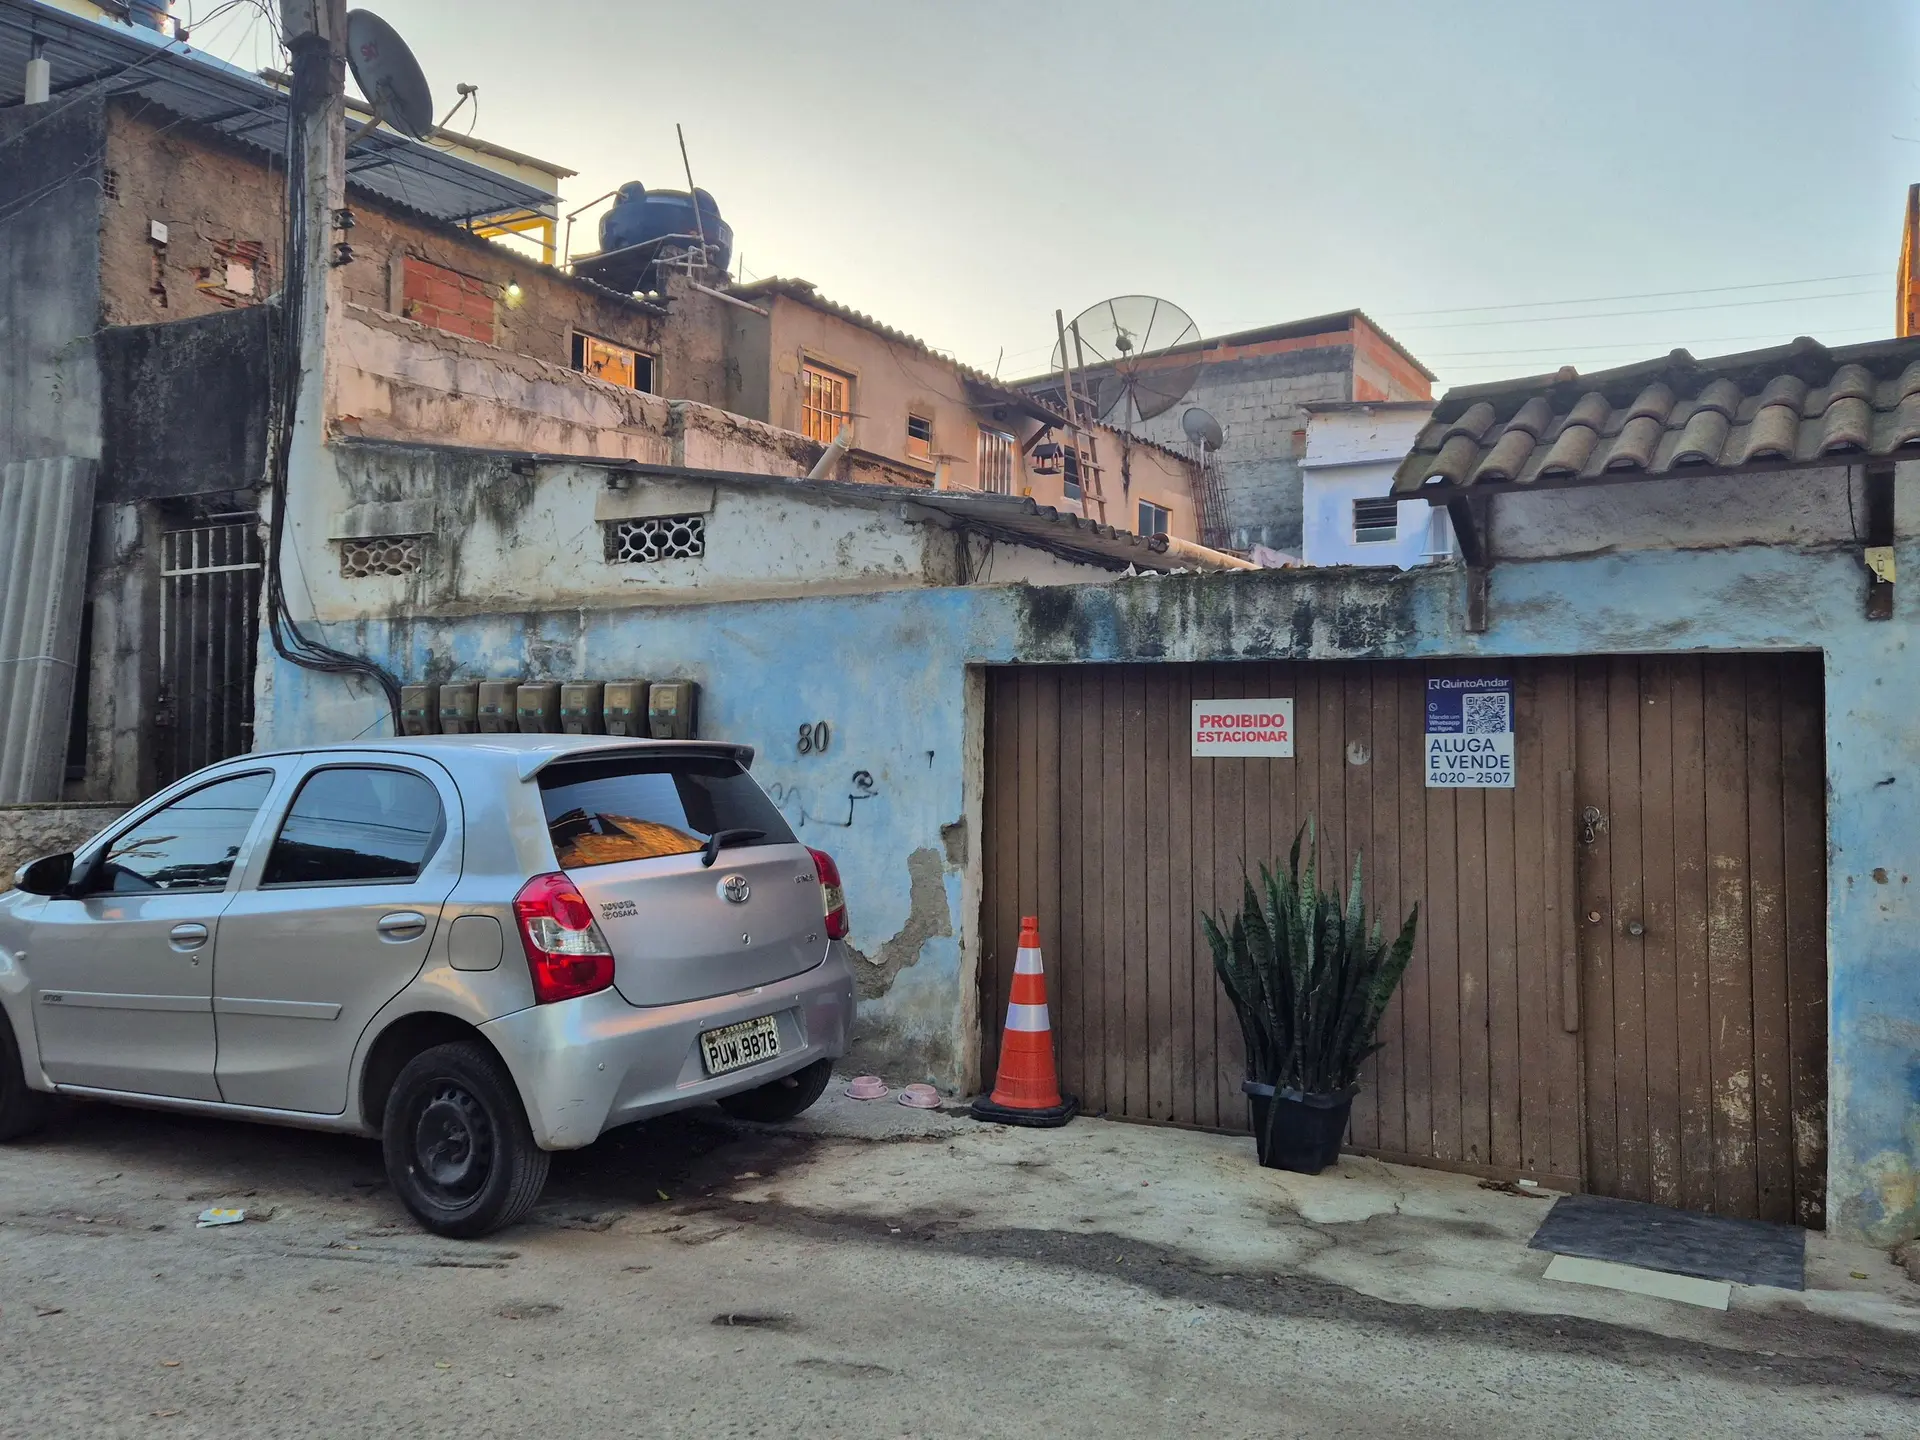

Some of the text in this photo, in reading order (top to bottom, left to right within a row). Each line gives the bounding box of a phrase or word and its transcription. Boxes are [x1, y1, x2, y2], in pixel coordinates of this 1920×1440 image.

[1441, 678, 1509, 689] QuintoAndar
[1199, 714, 1285, 728] PROIBIDO
[797, 720, 829, 754] 80
[1197, 731, 1288, 742] ESTACIONAR
[1430, 738, 1495, 752] ALUGA
[1431, 755, 1510, 769] E VENDE
[1430, 772, 1510, 783] 4020-2507
[612, 909, 639, 918] OSAKA
